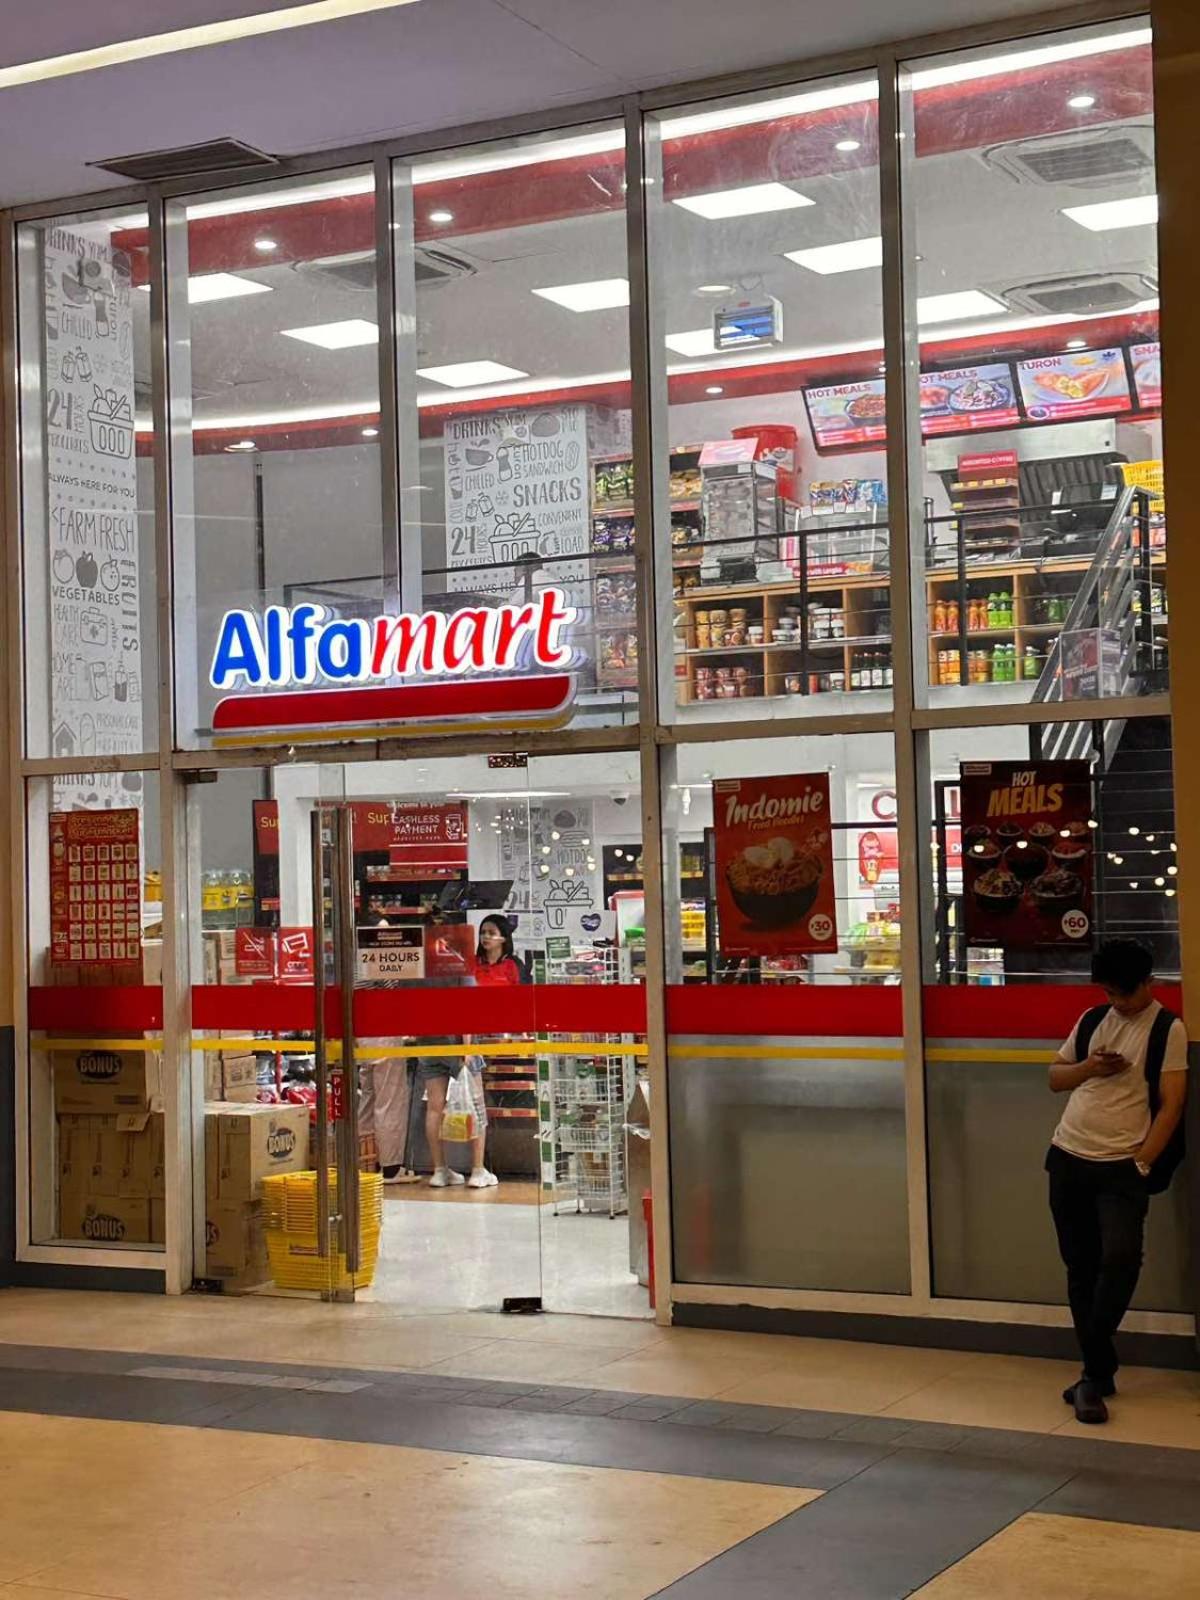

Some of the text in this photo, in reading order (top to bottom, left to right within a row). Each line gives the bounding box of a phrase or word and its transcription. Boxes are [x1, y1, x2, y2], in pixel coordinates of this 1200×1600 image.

[1020, 357, 1062, 371] TURON
[937, 369, 978, 382] MEALS
[808, 383, 872, 399] HOT MEALS
[453, 417, 501, 440] DRINKS
[523, 440, 565, 462] HOTDOG
[513, 477, 582, 507] SNACKS
[60, 507, 136, 553] FARM FRESH
[451, 525, 477, 556] 24
[52, 585, 120, 606] VEGETABLES
[210, 588, 574, 688] Alfamart
[1012, 771, 1037, 787] HOT
[725, 786, 824, 828] Indomie
[987, 783, 1064, 817] MEALS
[391, 814, 441, 824] CASHLESS
[394, 825, 438, 835] PAYMENT
[362, 952, 420, 963] 24 HOURS
[80, 1055, 121, 1073] BONUS
[334, 1077, 342, 1118] PULL
[267, 1133, 298, 1157] BONUS
[84, 1218, 124, 1240] BONUS
